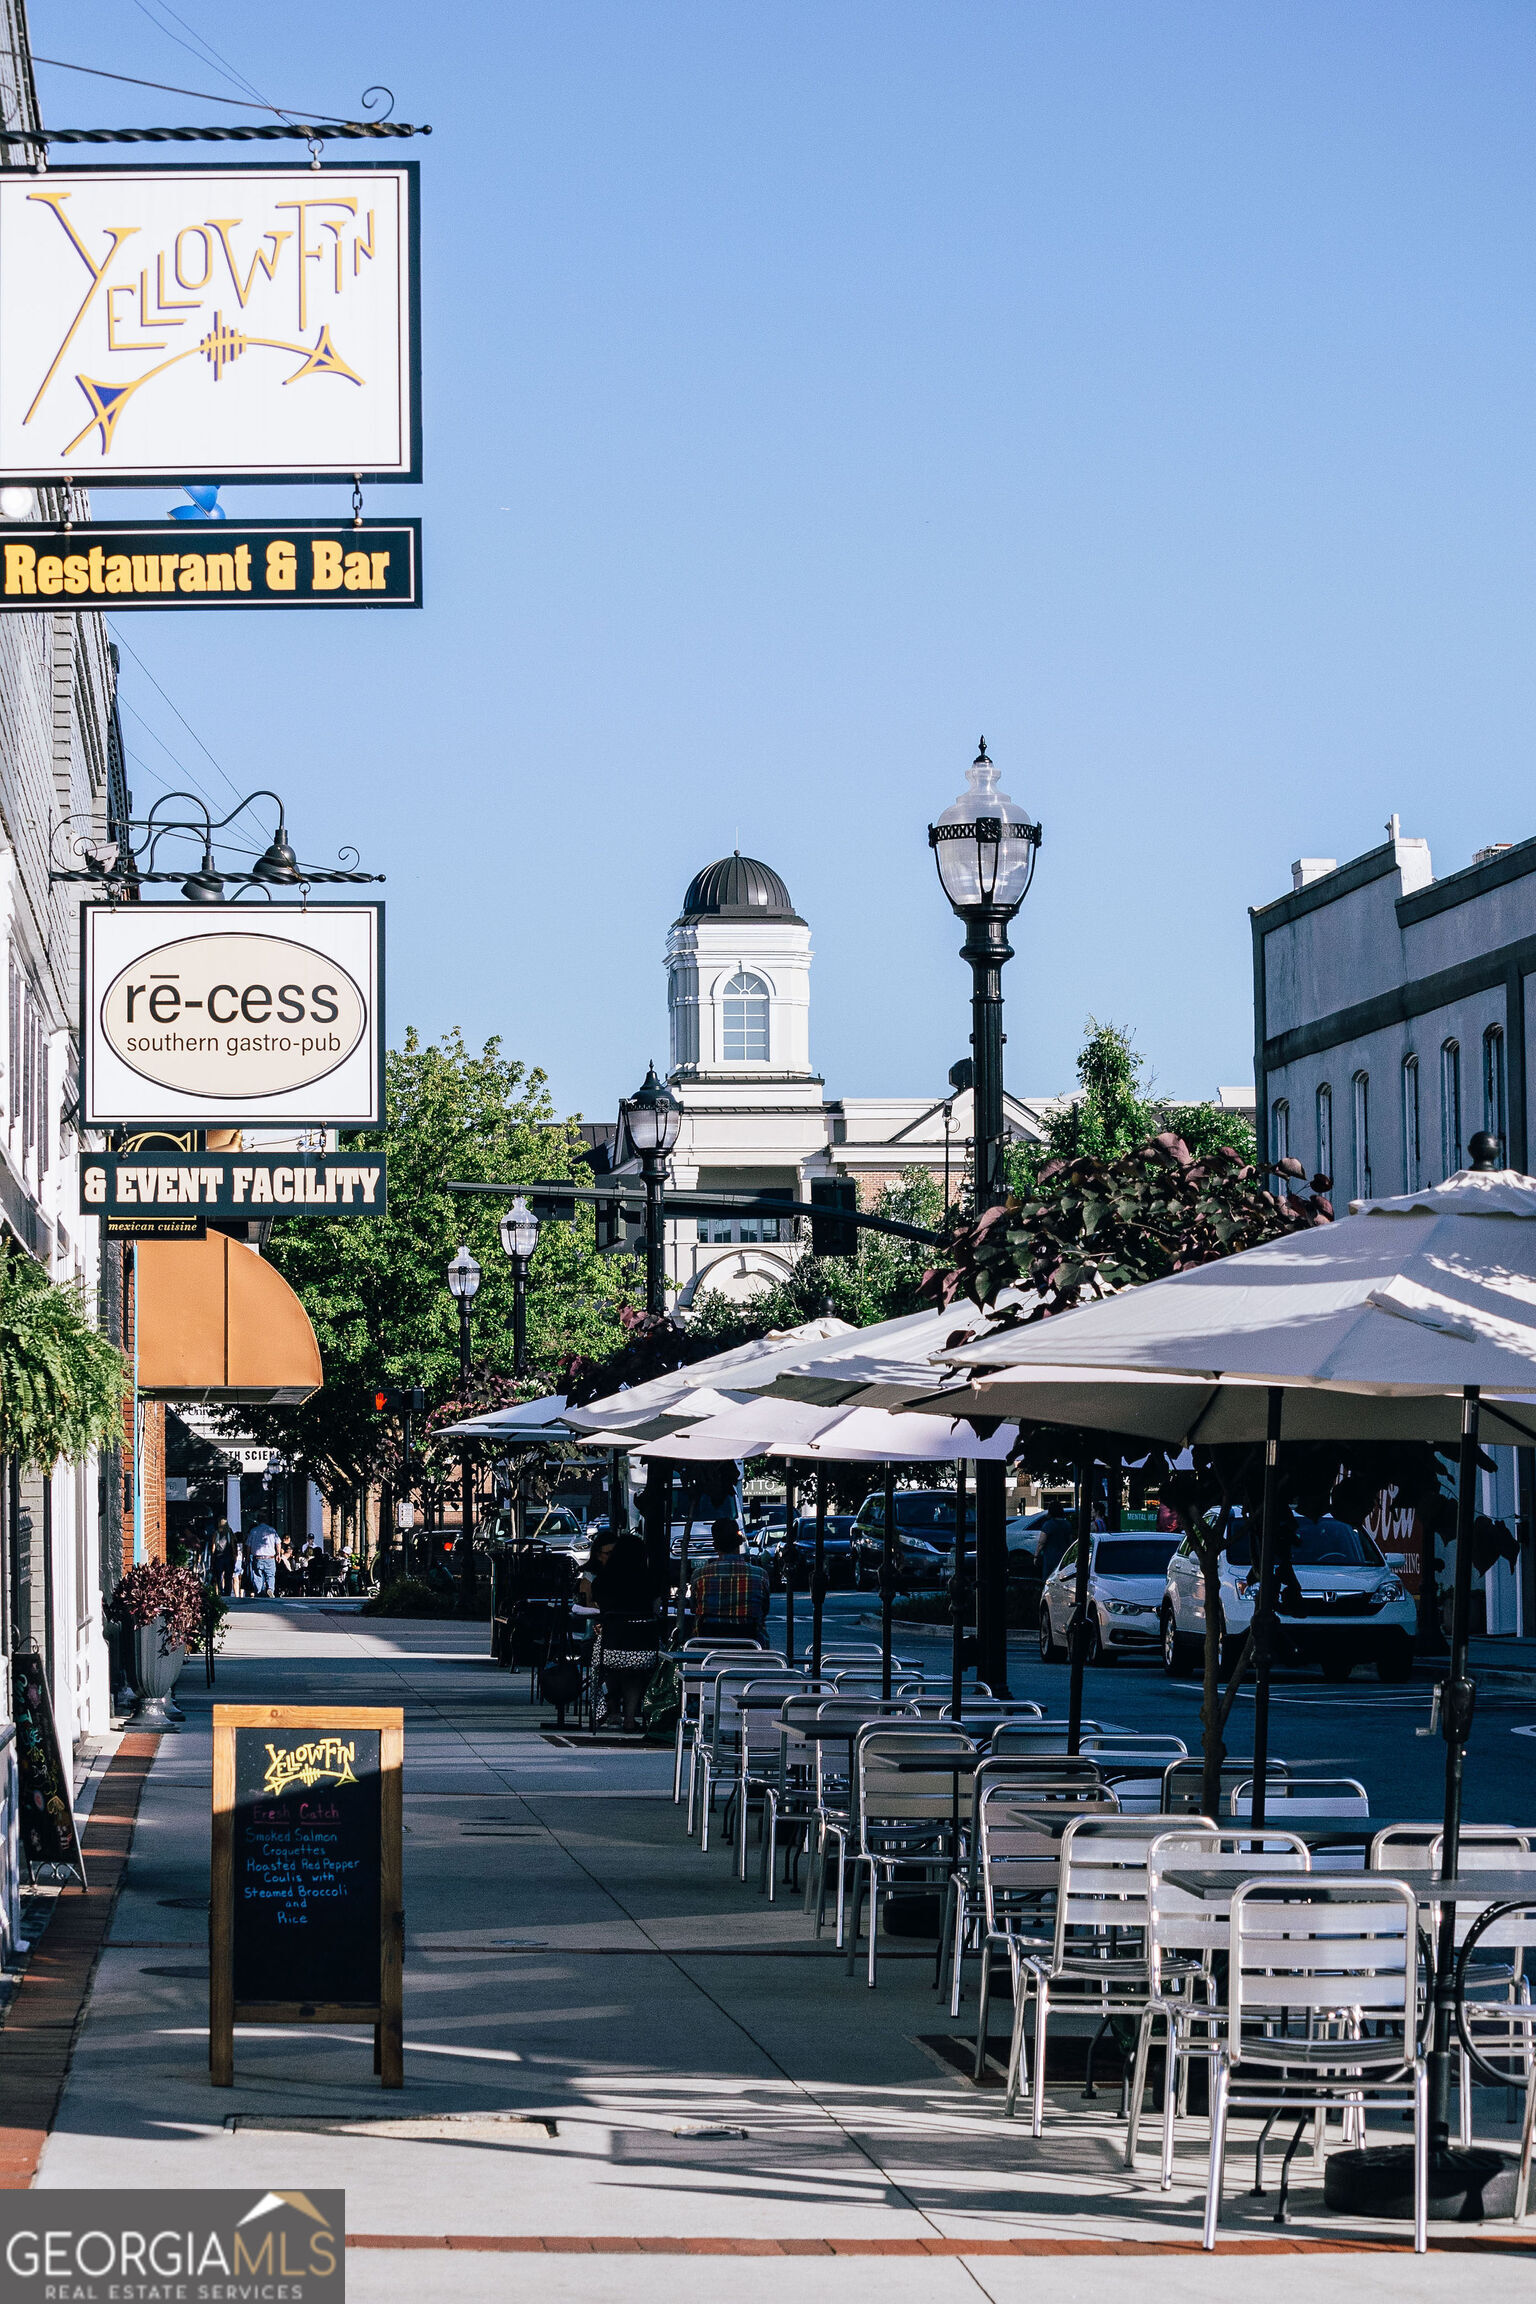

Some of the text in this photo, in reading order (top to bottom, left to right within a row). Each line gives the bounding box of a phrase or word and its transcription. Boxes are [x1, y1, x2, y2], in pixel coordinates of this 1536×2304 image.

[4, 540, 390, 595] Restaurant & Bar
[126, 1033, 341, 1056] southern gastro-pub
[84, 1166, 381, 1203] & EVENT FACILITY
[108, 1222, 197, 1231] mexican cuisine
[253, 1803, 340, 1820] Fresh Catch
[245, 1827, 338, 1842] Smoked Salmon
[263, 1843, 326, 1861] Croquettes
[247, 1858, 360, 1872] Roasted Red Pepper
[263, 1871, 335, 1883] Coulis with
[244, 1884, 348, 1899] Steamed Broccoli
[285, 1899, 308, 1909] and
[277, 1911, 308, 1925] Rice
